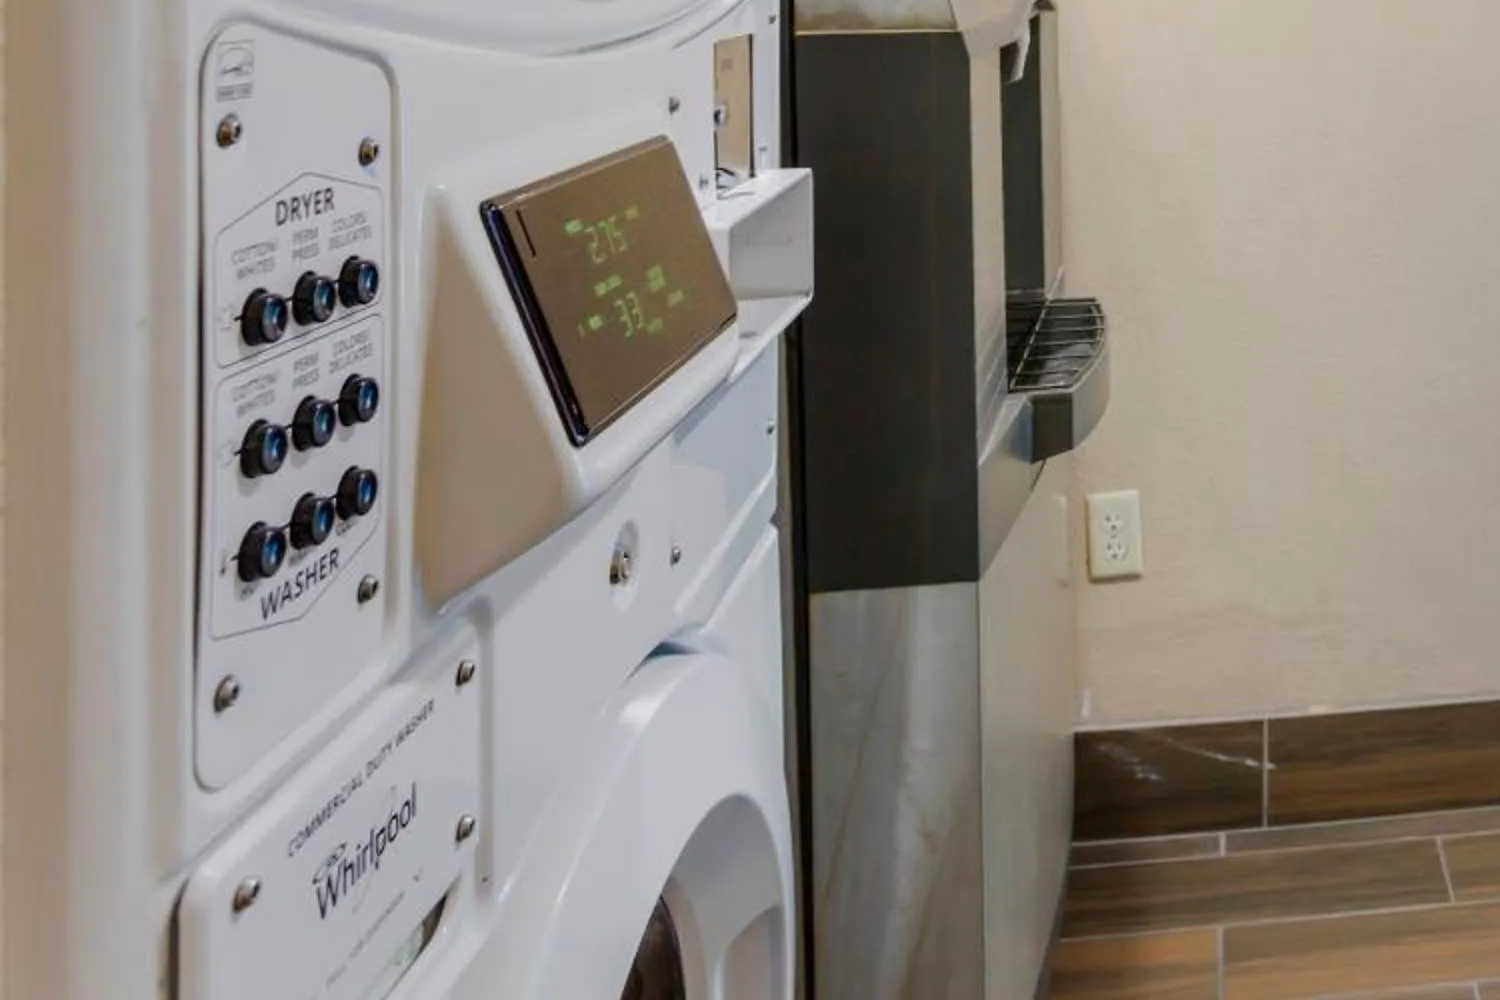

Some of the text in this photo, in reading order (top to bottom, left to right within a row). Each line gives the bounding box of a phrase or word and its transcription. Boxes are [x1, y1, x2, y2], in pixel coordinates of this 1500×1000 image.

[275, 187, 336, 227] DRYER
[261, 547, 340, 620] WASHER
[316, 781, 418, 920] Whirlpool
